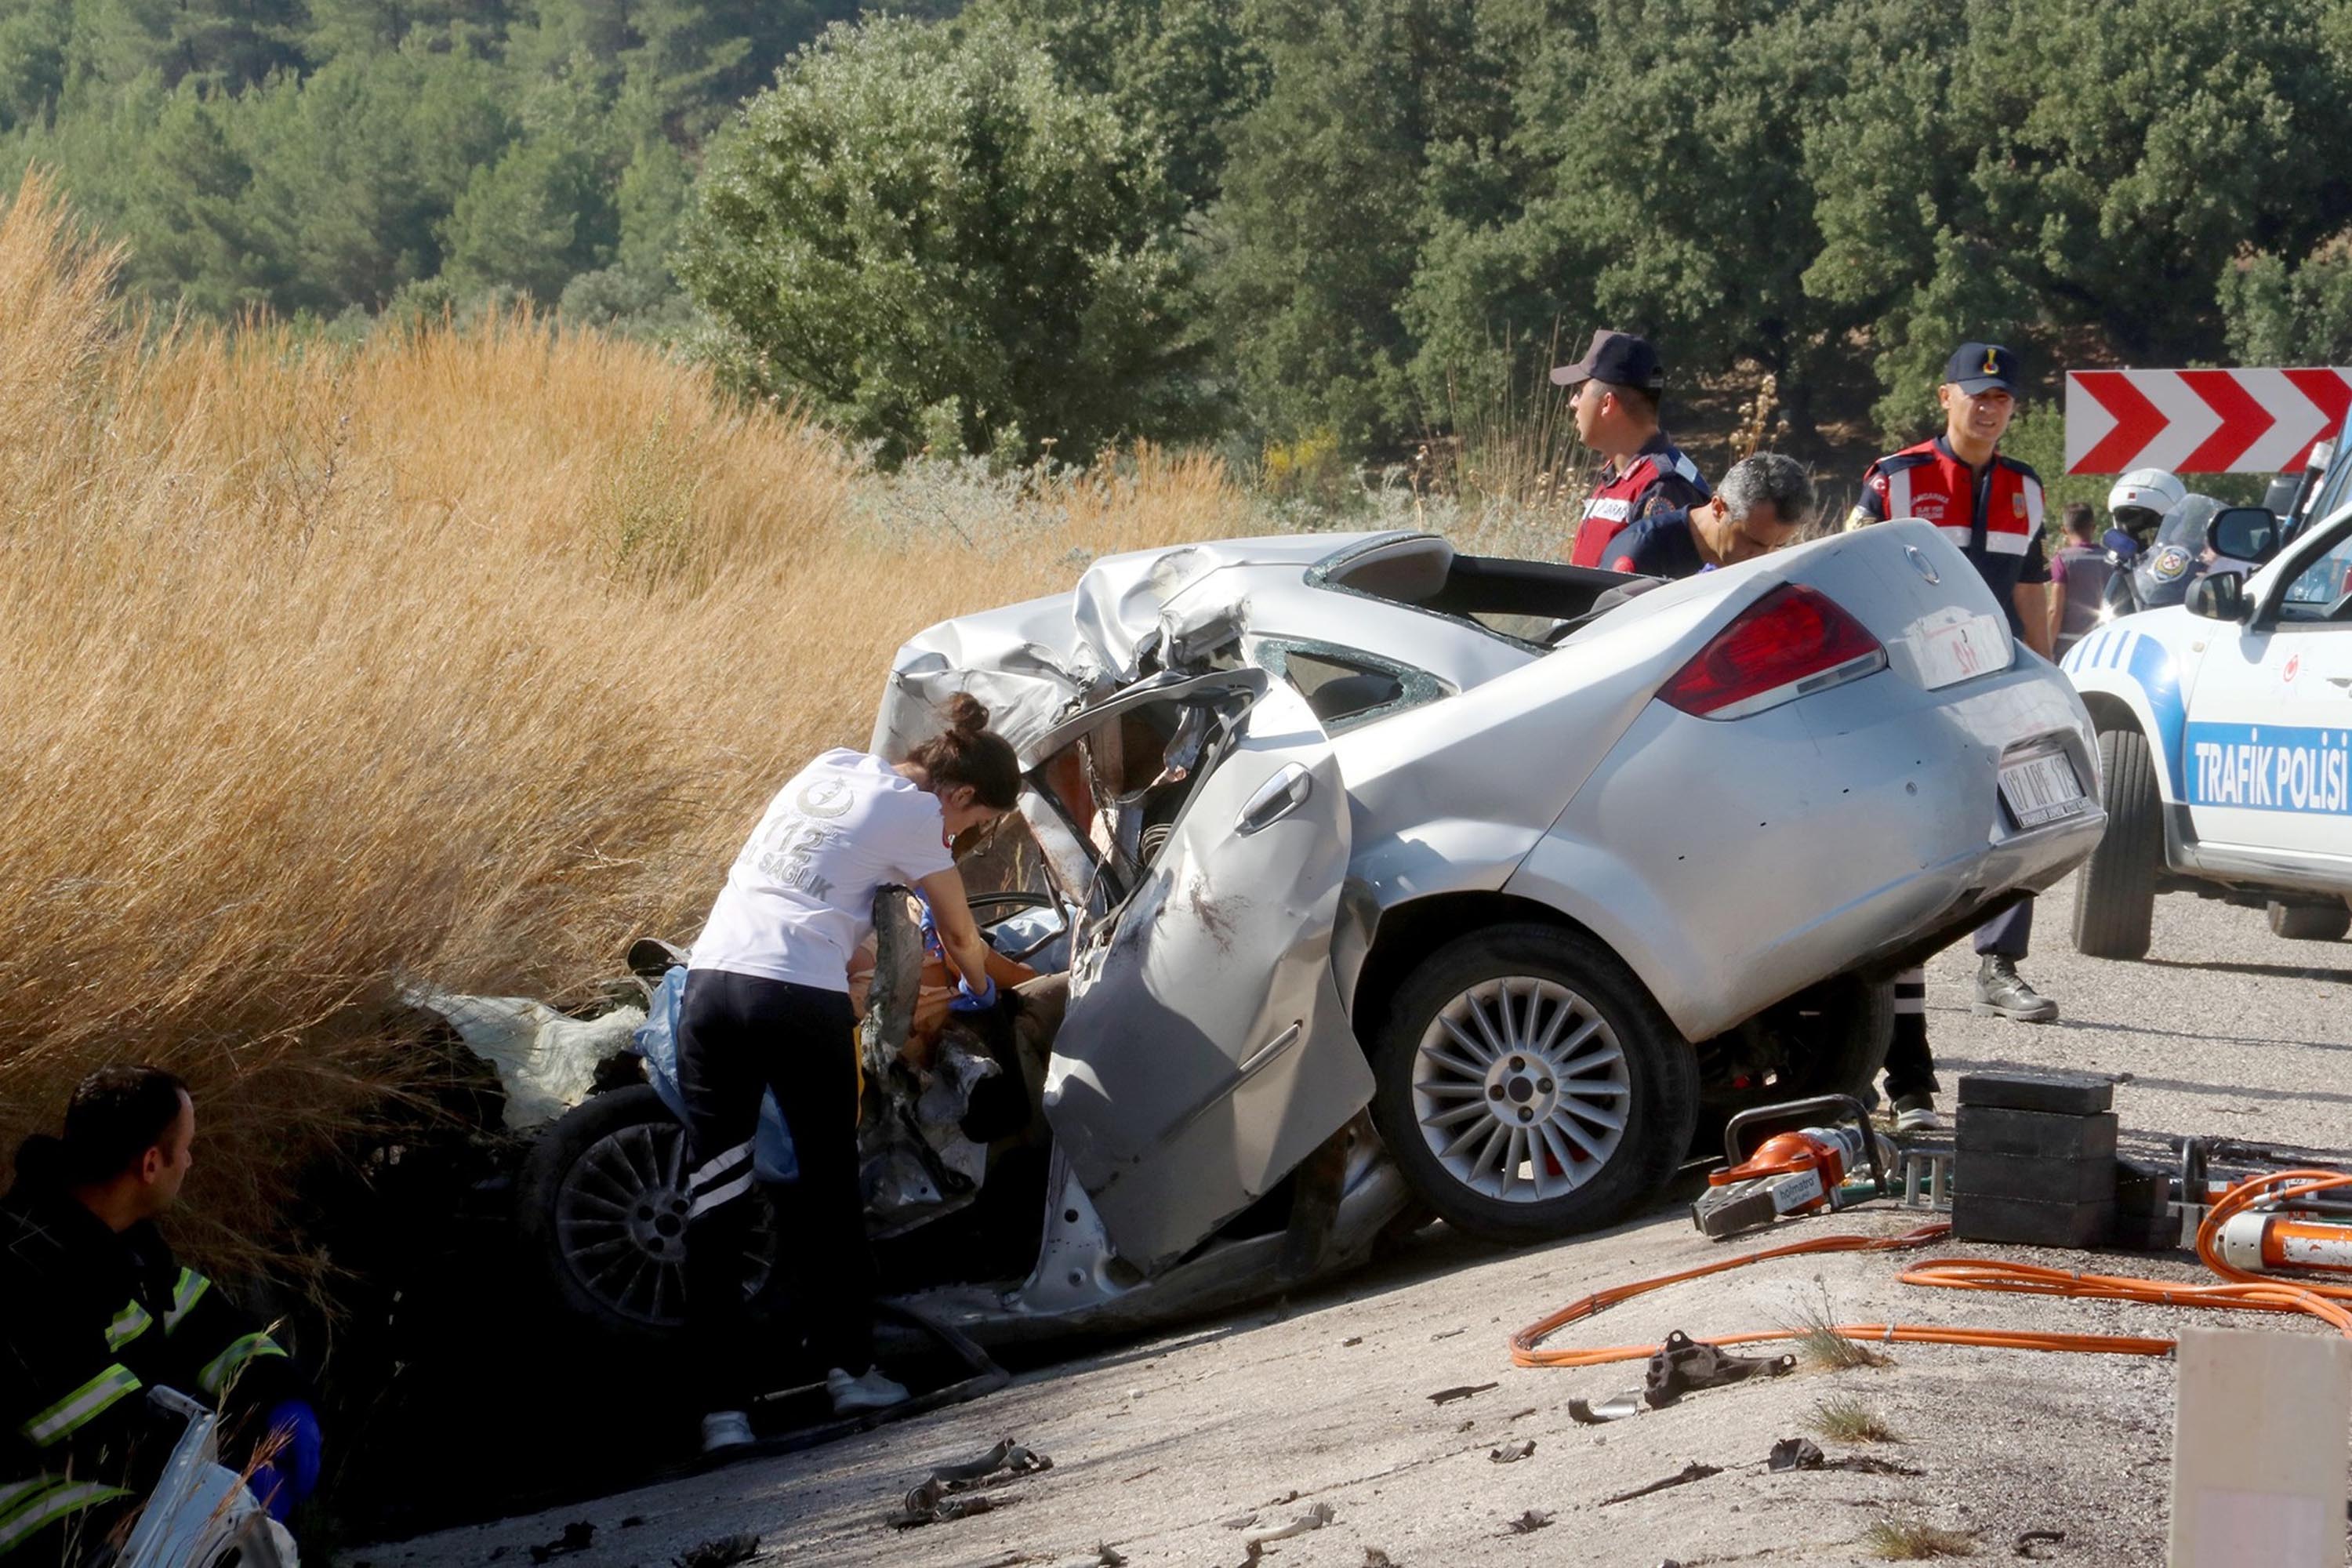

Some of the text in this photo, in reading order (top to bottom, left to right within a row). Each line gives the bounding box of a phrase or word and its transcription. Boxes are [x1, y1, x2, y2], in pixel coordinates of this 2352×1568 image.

[2196, 727, 2348, 811] TRAFİK POLİSİ
[764, 813, 823, 864] 112
[1779, 1177, 1814, 1200] holmatro
